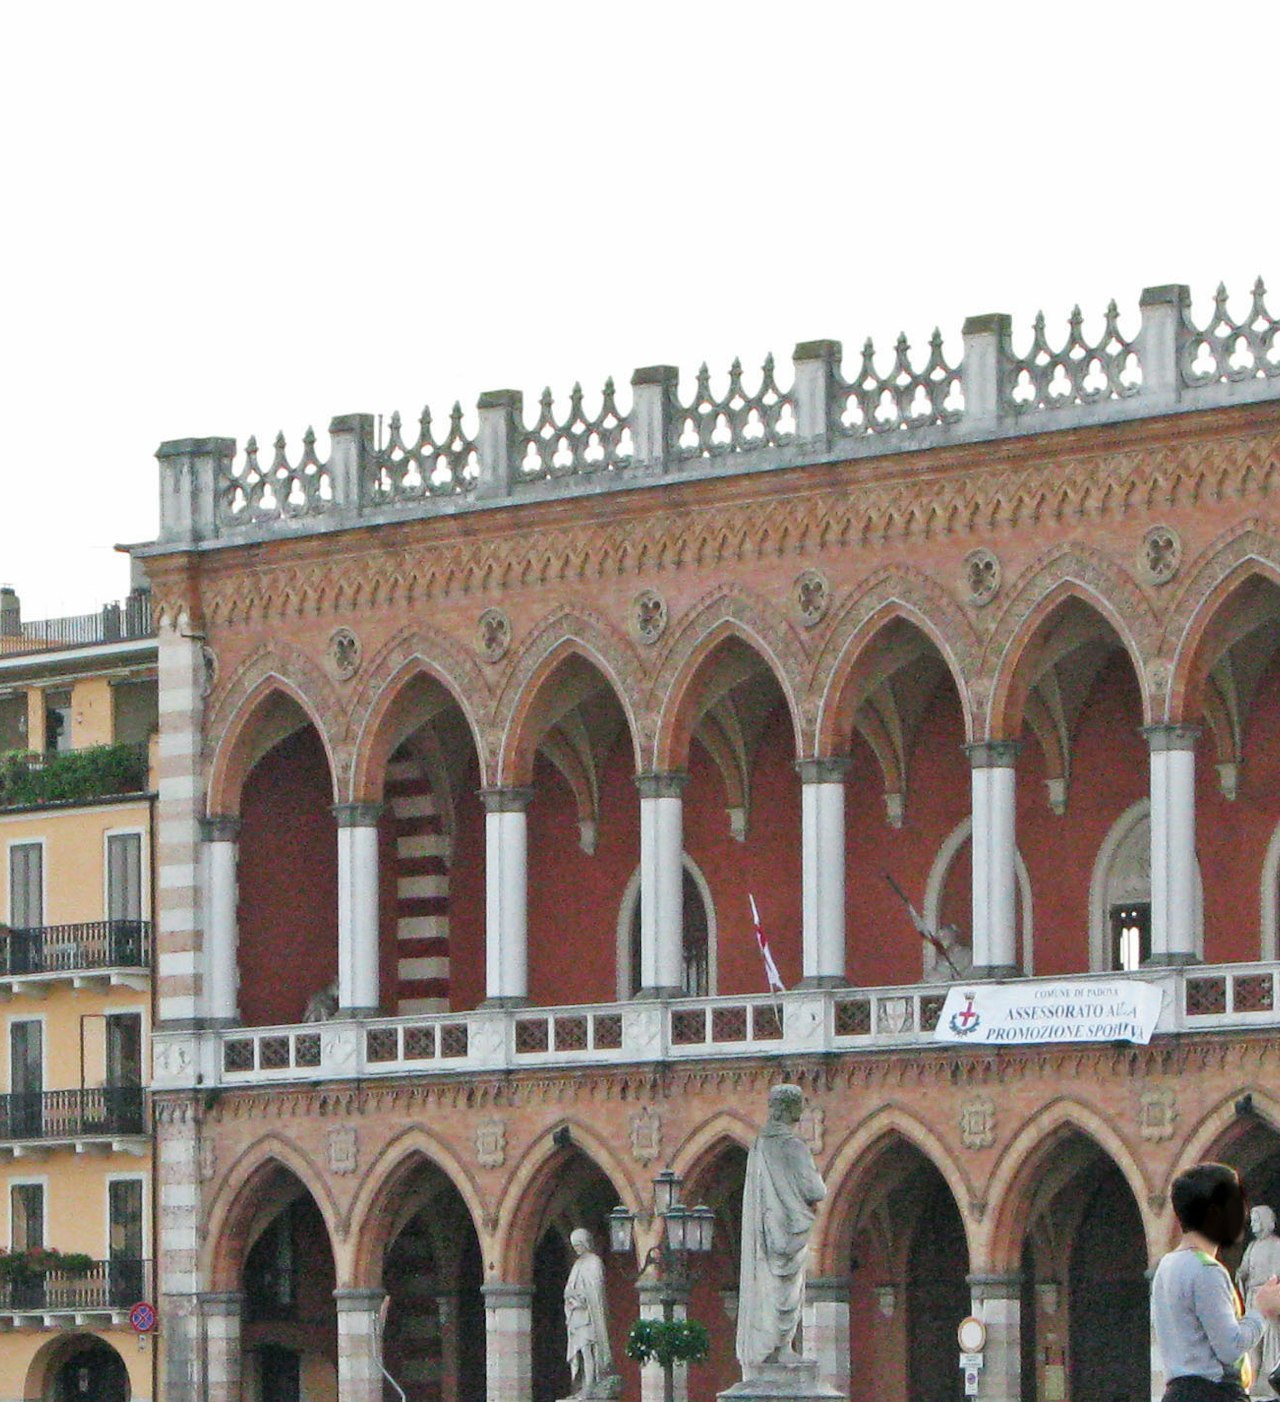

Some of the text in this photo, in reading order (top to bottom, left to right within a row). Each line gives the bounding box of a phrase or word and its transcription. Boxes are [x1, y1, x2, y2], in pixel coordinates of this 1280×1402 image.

[1074, 988, 1084, 997] DI
[1005, 1003, 1104, 1020] ASSESSORATO
[986, 1023, 1086, 1040] PROMOZIONE
